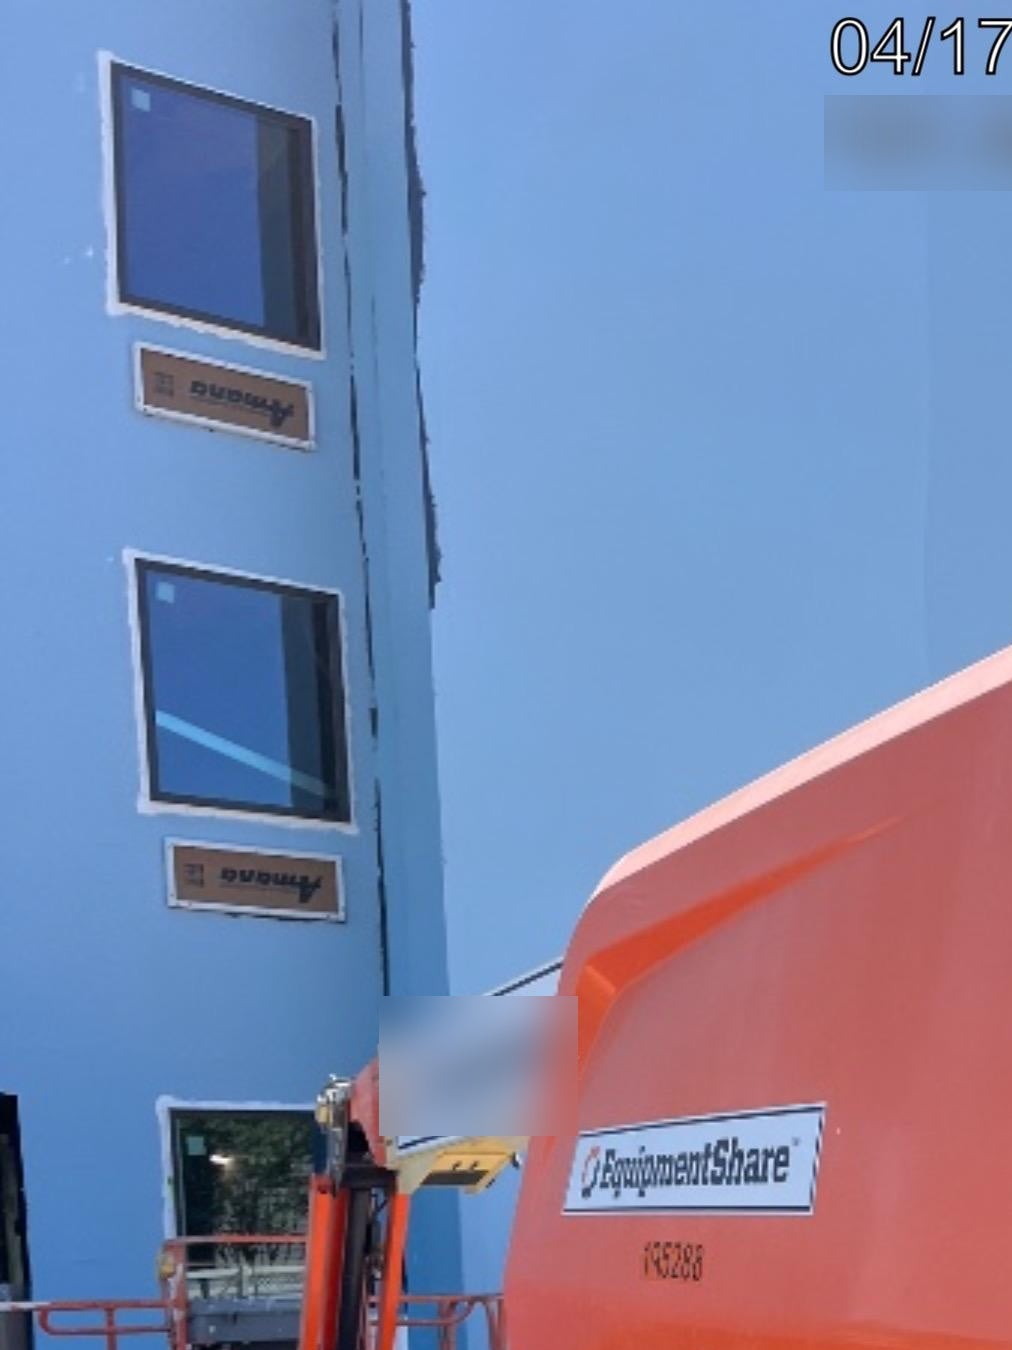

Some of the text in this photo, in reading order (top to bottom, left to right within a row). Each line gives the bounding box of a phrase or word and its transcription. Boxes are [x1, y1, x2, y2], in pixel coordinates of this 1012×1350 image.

[190, 380, 295, 428] Amana
[220, 866, 323, 904] Amana
[599, 1137, 790, 1198] EquipmentShare
[643, 1241, 704, 1281] 195288
